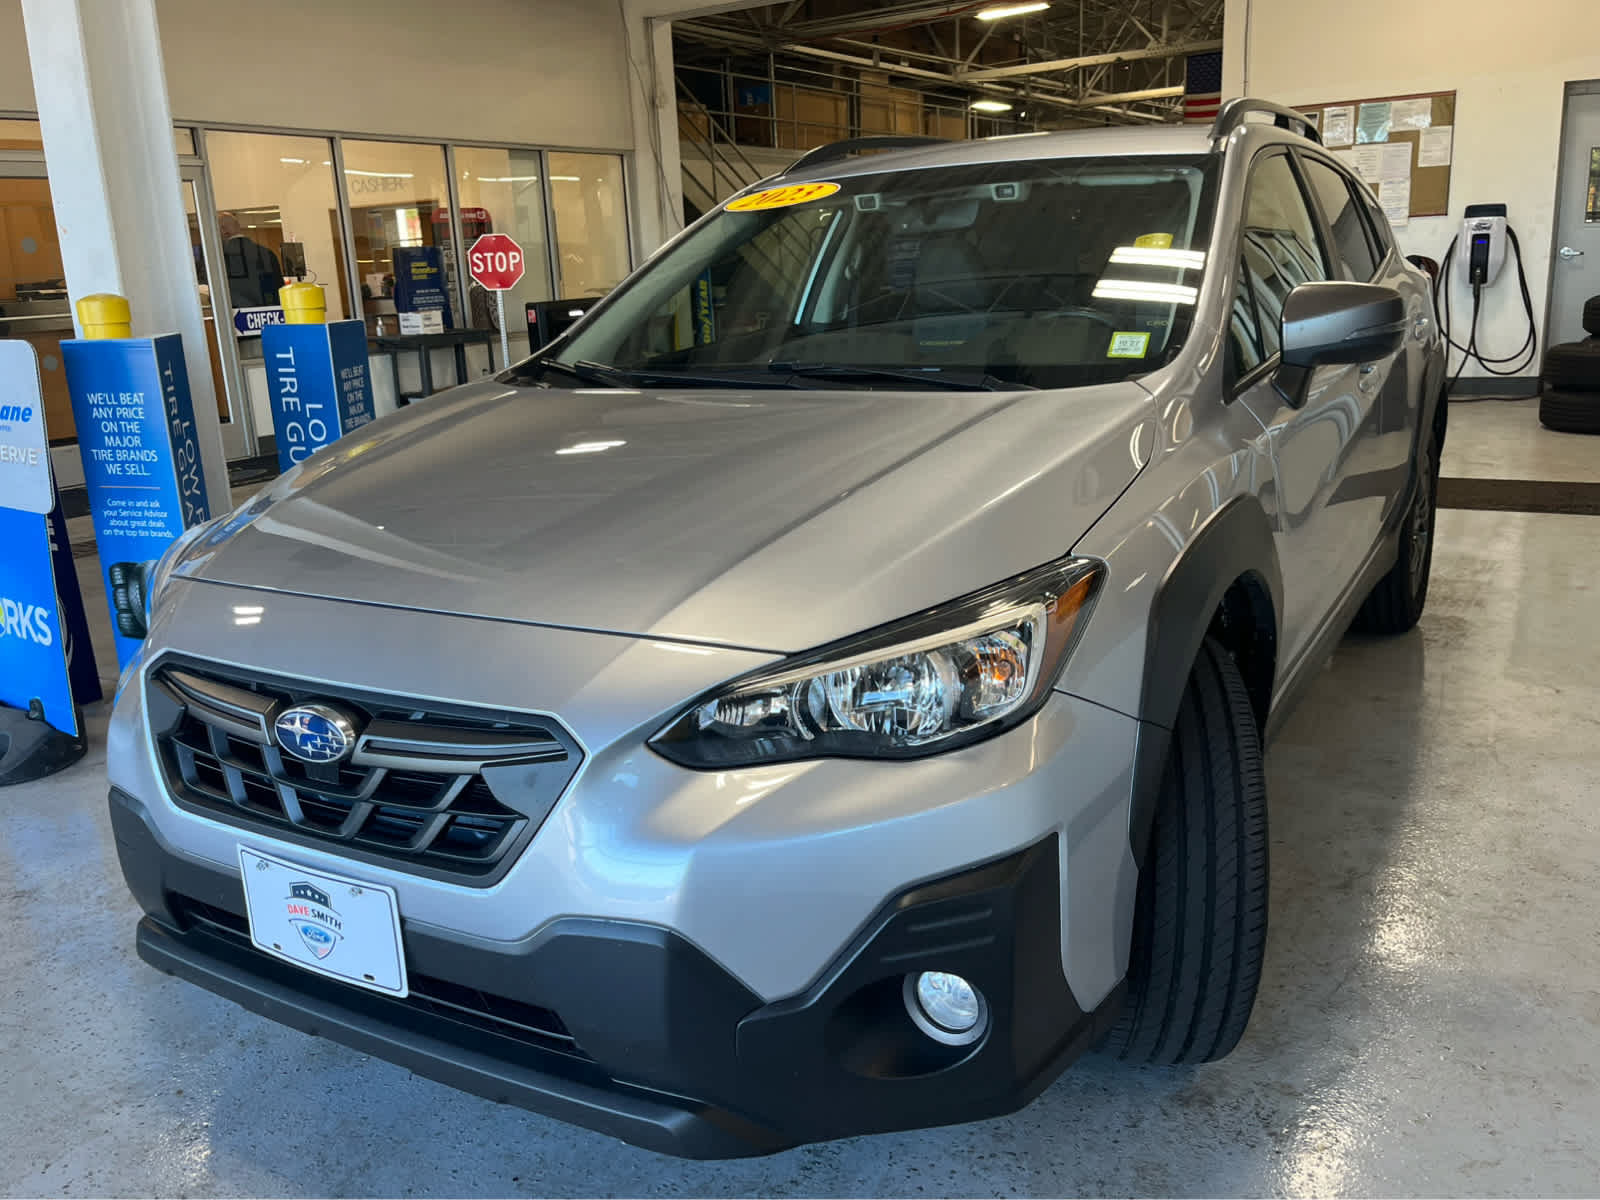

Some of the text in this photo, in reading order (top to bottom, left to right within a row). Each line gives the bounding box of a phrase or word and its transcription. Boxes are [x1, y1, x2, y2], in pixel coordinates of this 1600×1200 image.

[472, 251, 520, 273] STOP
[276, 346, 301, 412] TIRE
[87, 392, 145, 405] WE'LL BEAT
[164, 359, 183, 438] TIRE
[92, 407, 145, 419] ANY PRICE
[101, 421, 141, 433] ON THE
[305, 403, 329, 454] LO
[104, 435, 142, 447] MAJOR
[90, 449, 159, 462] TIRE BRANDS
[182, 420, 201, 495] LOW
[105, 463, 122, 475] WE
[107, 498, 127, 507] Come
[103, 510, 118, 518] your
[119, 509, 142, 517] Service
[109, 518, 166, 529] about great deals
[287, 903, 342, 930] DAVE SMITH
